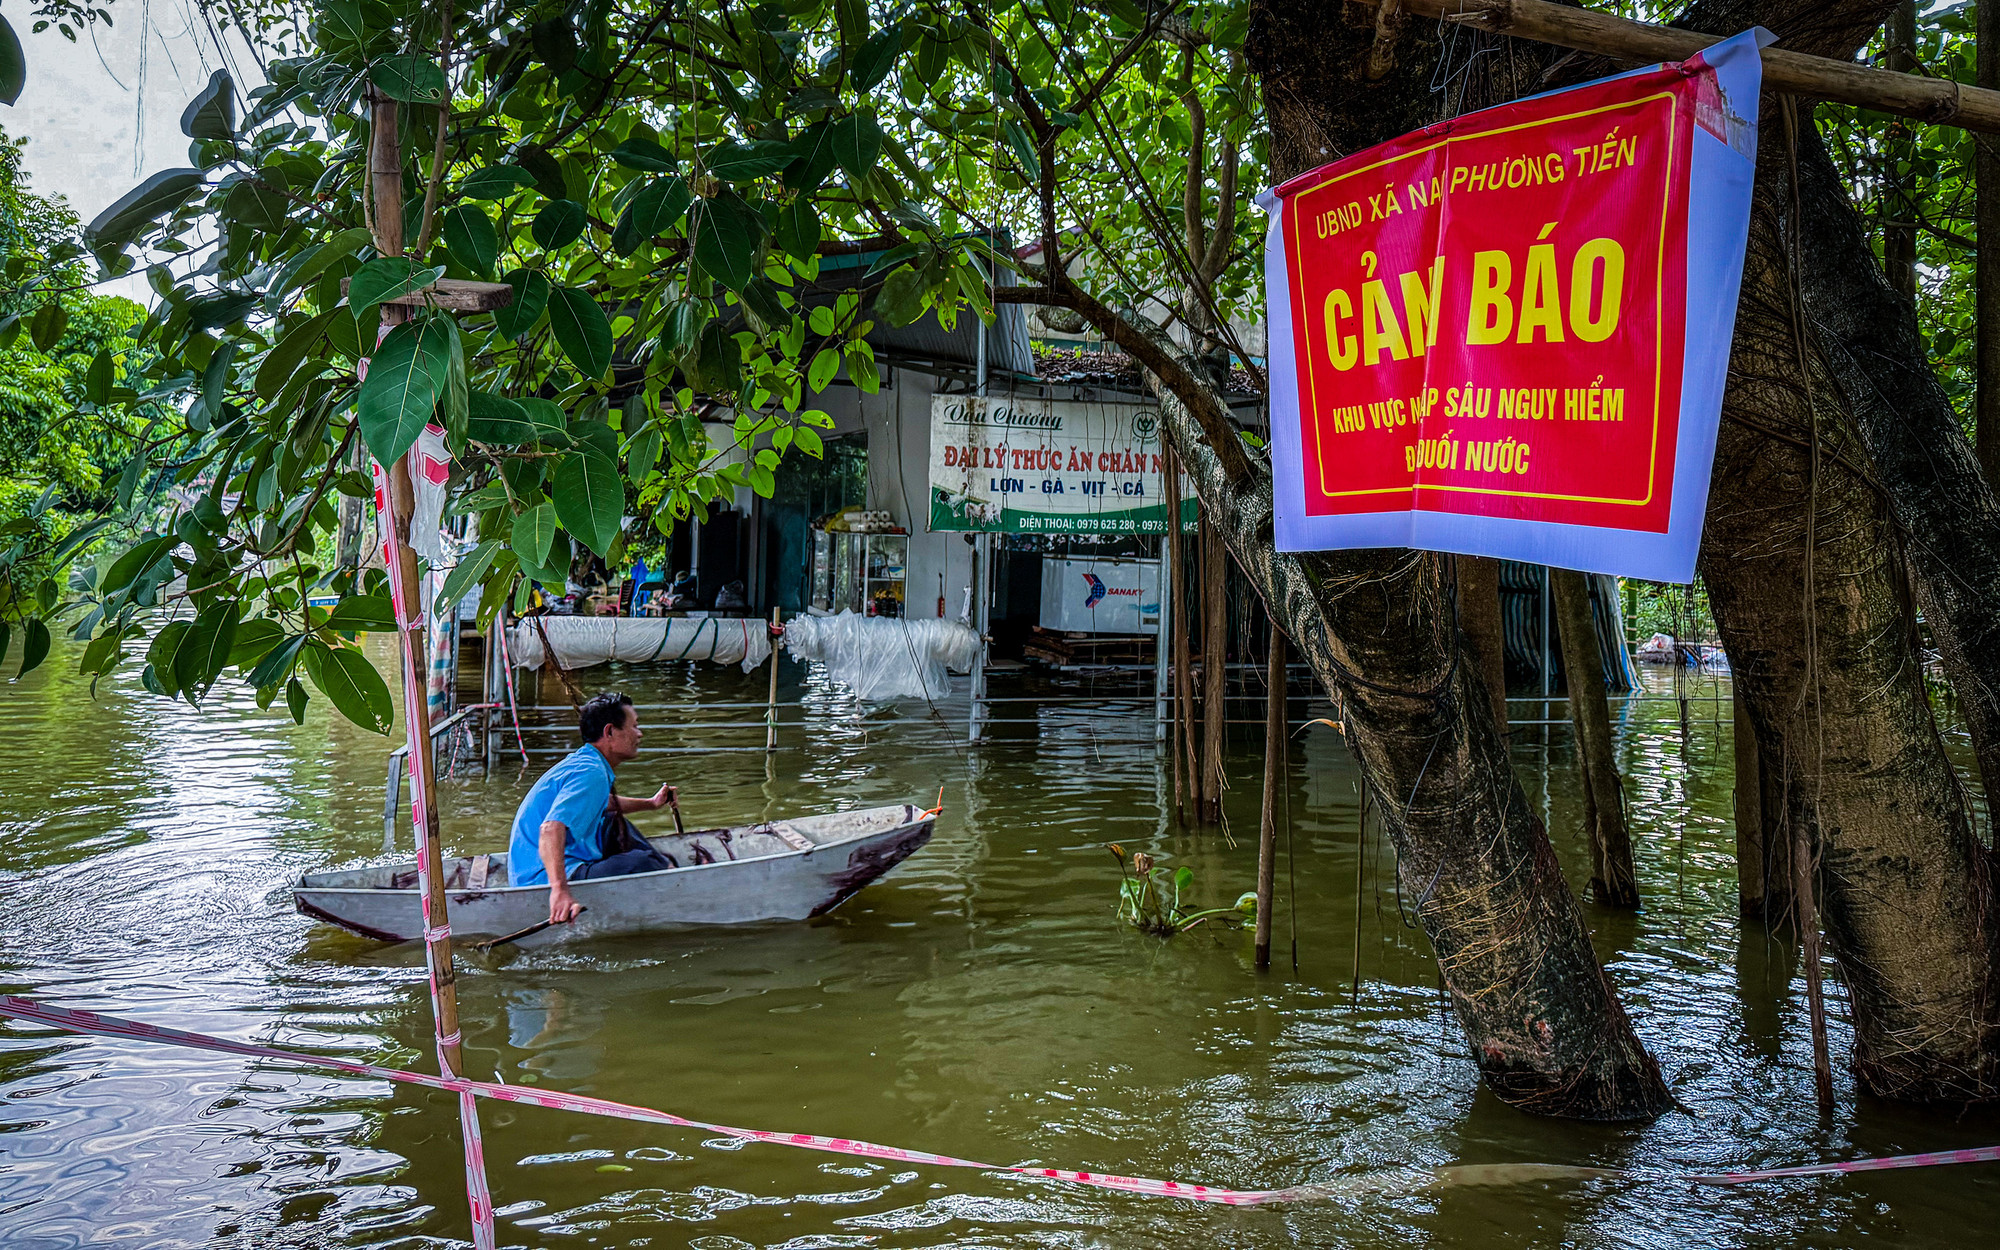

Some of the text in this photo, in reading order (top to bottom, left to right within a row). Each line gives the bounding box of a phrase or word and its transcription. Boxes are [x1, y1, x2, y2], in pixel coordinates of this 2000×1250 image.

[1316, 201, 1362, 239] UBND
[1368, 182, 1403, 222] XÃ
[1450, 154, 1565, 194] PHƯƠNG
[1573, 126, 1638, 177] TIẾN
[1466, 221, 1625, 345] BÁO
[1333, 405, 1366, 434] KHU
[1368, 398, 1407, 433] VỰC
[1444, 381, 1491, 418] SÂU
[1497, 388, 1558, 420] NGUY
[1564, 375, 1625, 421] HIỂM
[944, 446, 979, 473] ĐẠI
[983, 442, 1007, 469] LÝ
[1011, 444, 1063, 471] THỨC
[1066, 445, 1093, 472] ĂN
[1098, 447, 1147, 473] CHĂN
[1465, 436, 1530, 475] NƯỚC
[990, 477, 1024, 496] LỢN
[1042, 477, 1065, 494] GÀ
[1081, 480, 1106, 497] VỊT
[1123, 480, 1145, 496] CÁ
[1019, 514, 1042, 531] ĐIỆN
[1044, 518, 1075, 532] THOẠI:
[1077, 518, 1099, 530] 0979
[1101, 519, 1117, 531] 625
[1119, 519, 1135, 531] 280
[1107, 587, 1145, 597] SANAKY
